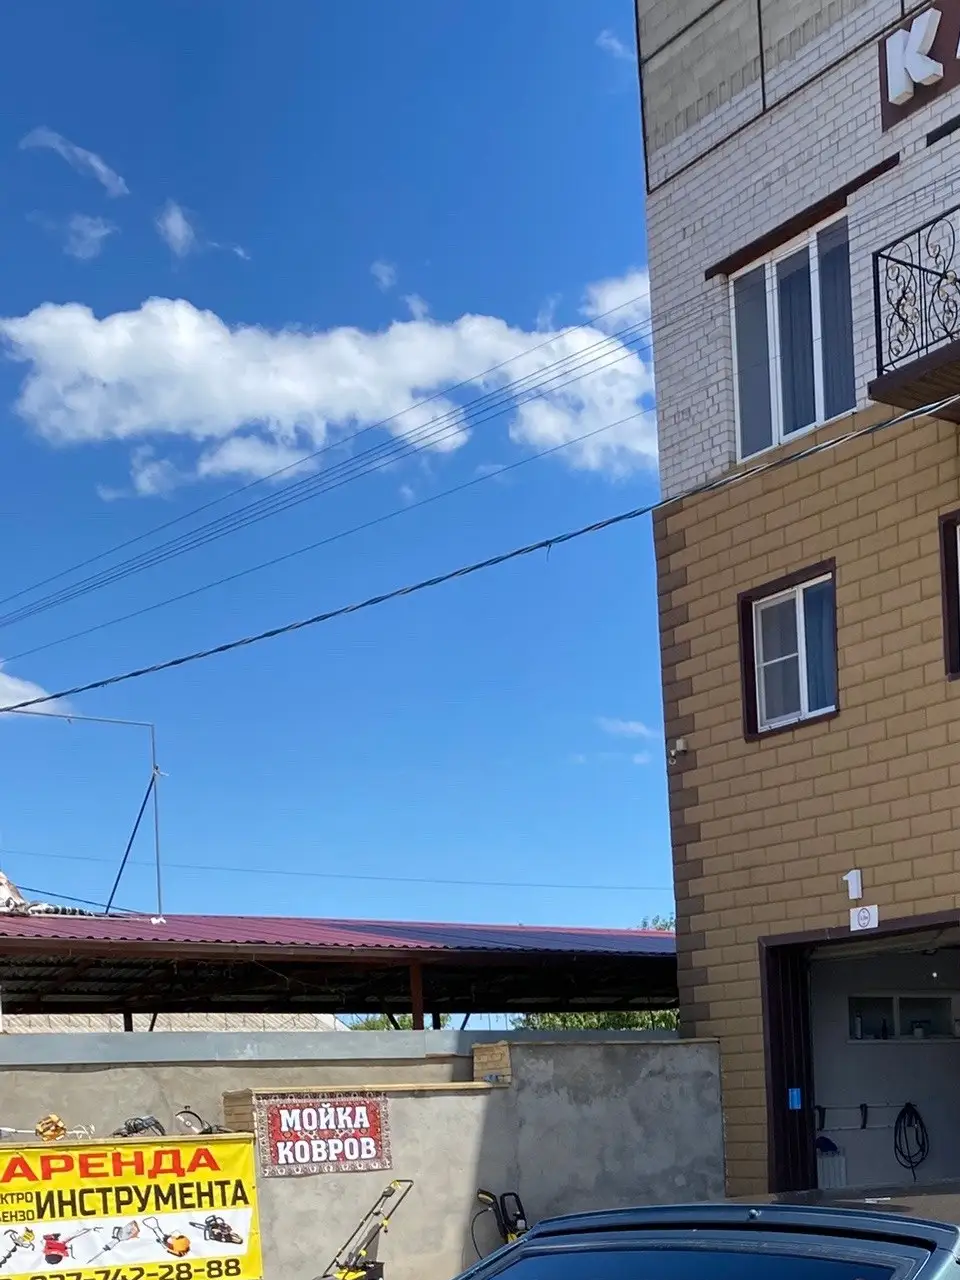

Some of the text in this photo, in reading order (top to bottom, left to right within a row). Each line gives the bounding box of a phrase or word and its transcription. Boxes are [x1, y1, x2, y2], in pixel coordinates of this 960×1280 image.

[842, 869, 863, 900] 1
[280, 1102, 370, 1132] МОЙКА
[0, 1147, 221, 1183] АРЕНДА
[276, 1137, 377, 1164] КОВРОВ
[0, 1191, 33, 1204] КТРО
[36, 1179, 250, 1220] ИНСТРУМЕНТА
[0, 1209, 35, 1222] ЕНЗО
